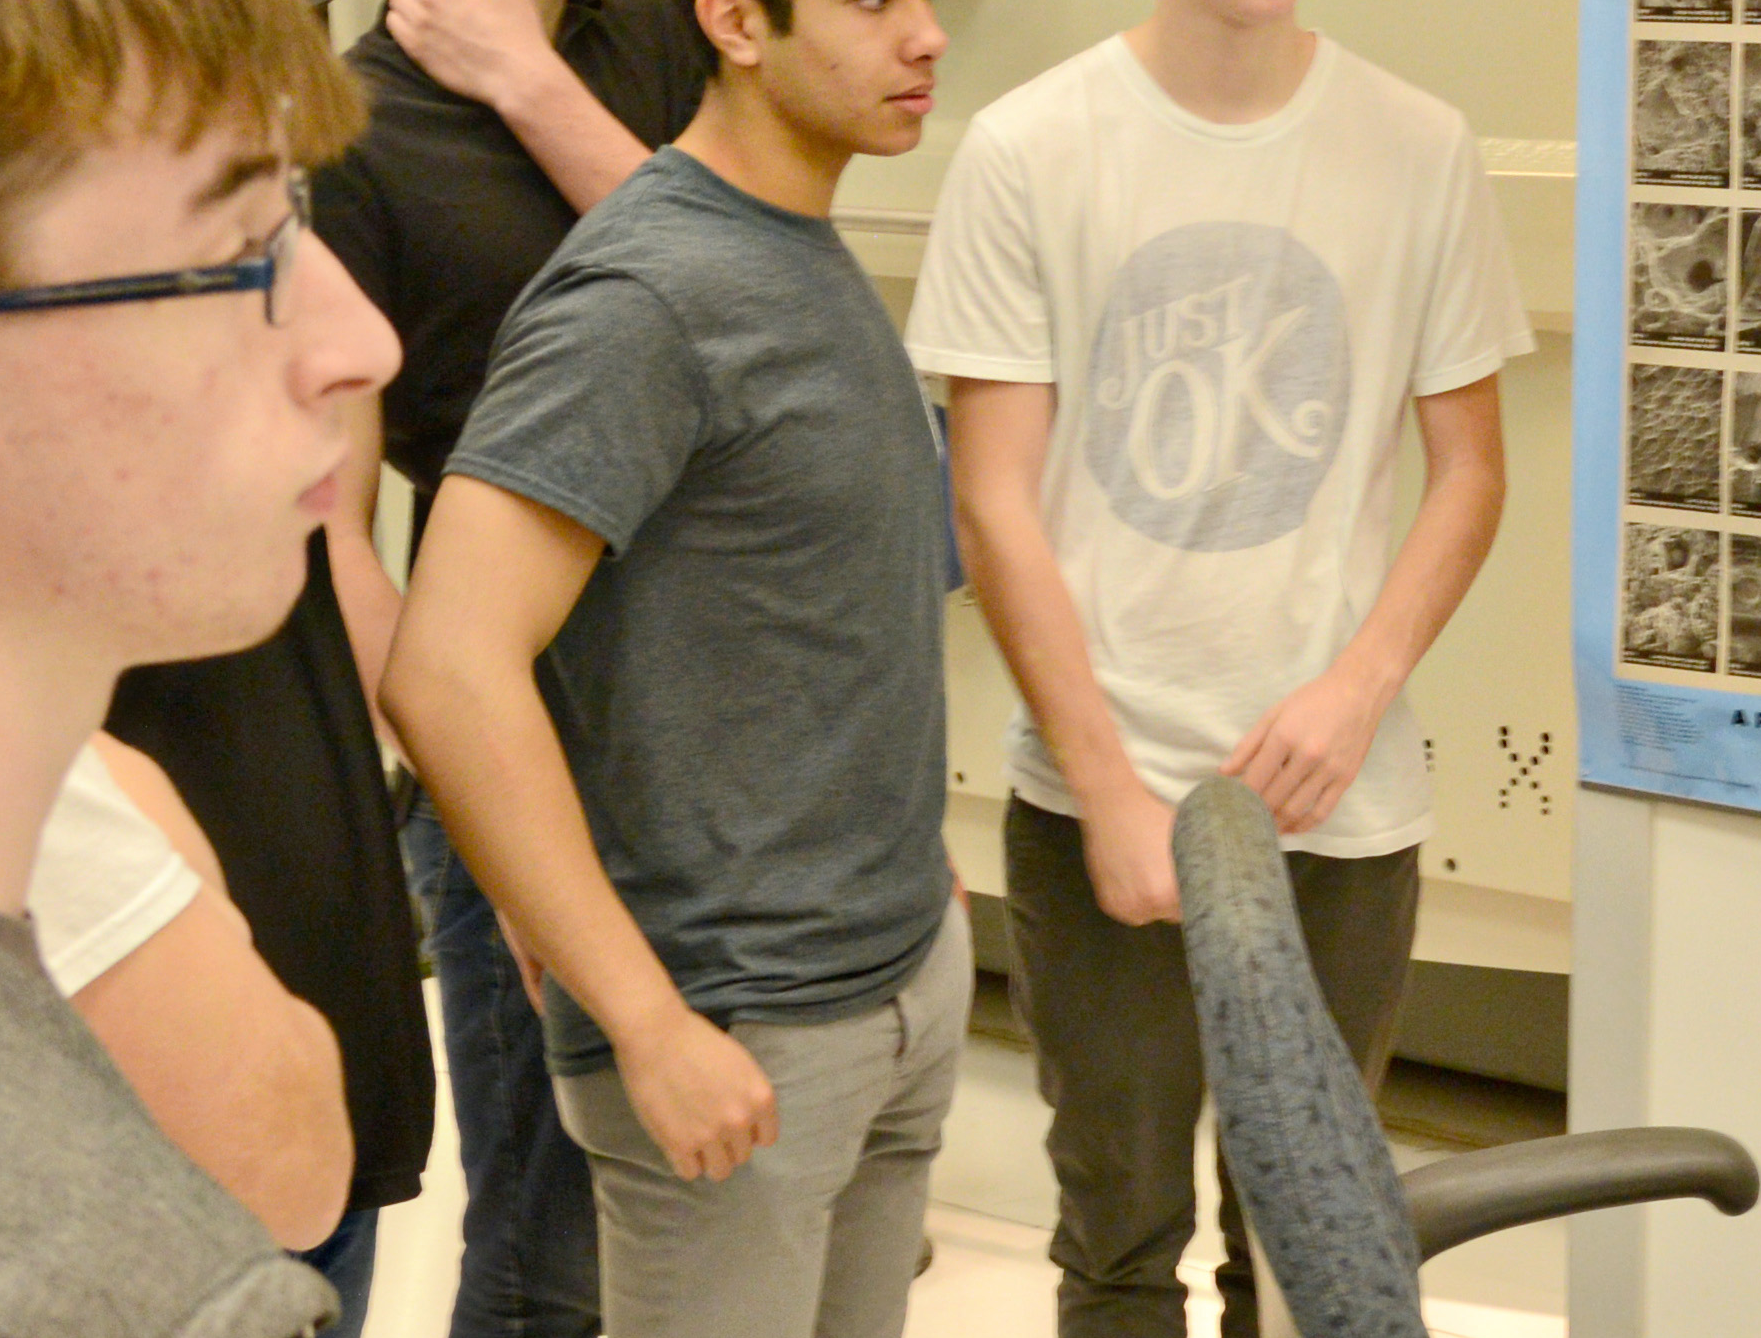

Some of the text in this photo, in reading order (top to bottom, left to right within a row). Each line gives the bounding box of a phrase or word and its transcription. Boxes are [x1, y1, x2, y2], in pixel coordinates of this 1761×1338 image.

[1096, 273, 1254, 411] JUST
[1129, 304, 1334, 501] OK
[1731, 709, 1748, 726] A
